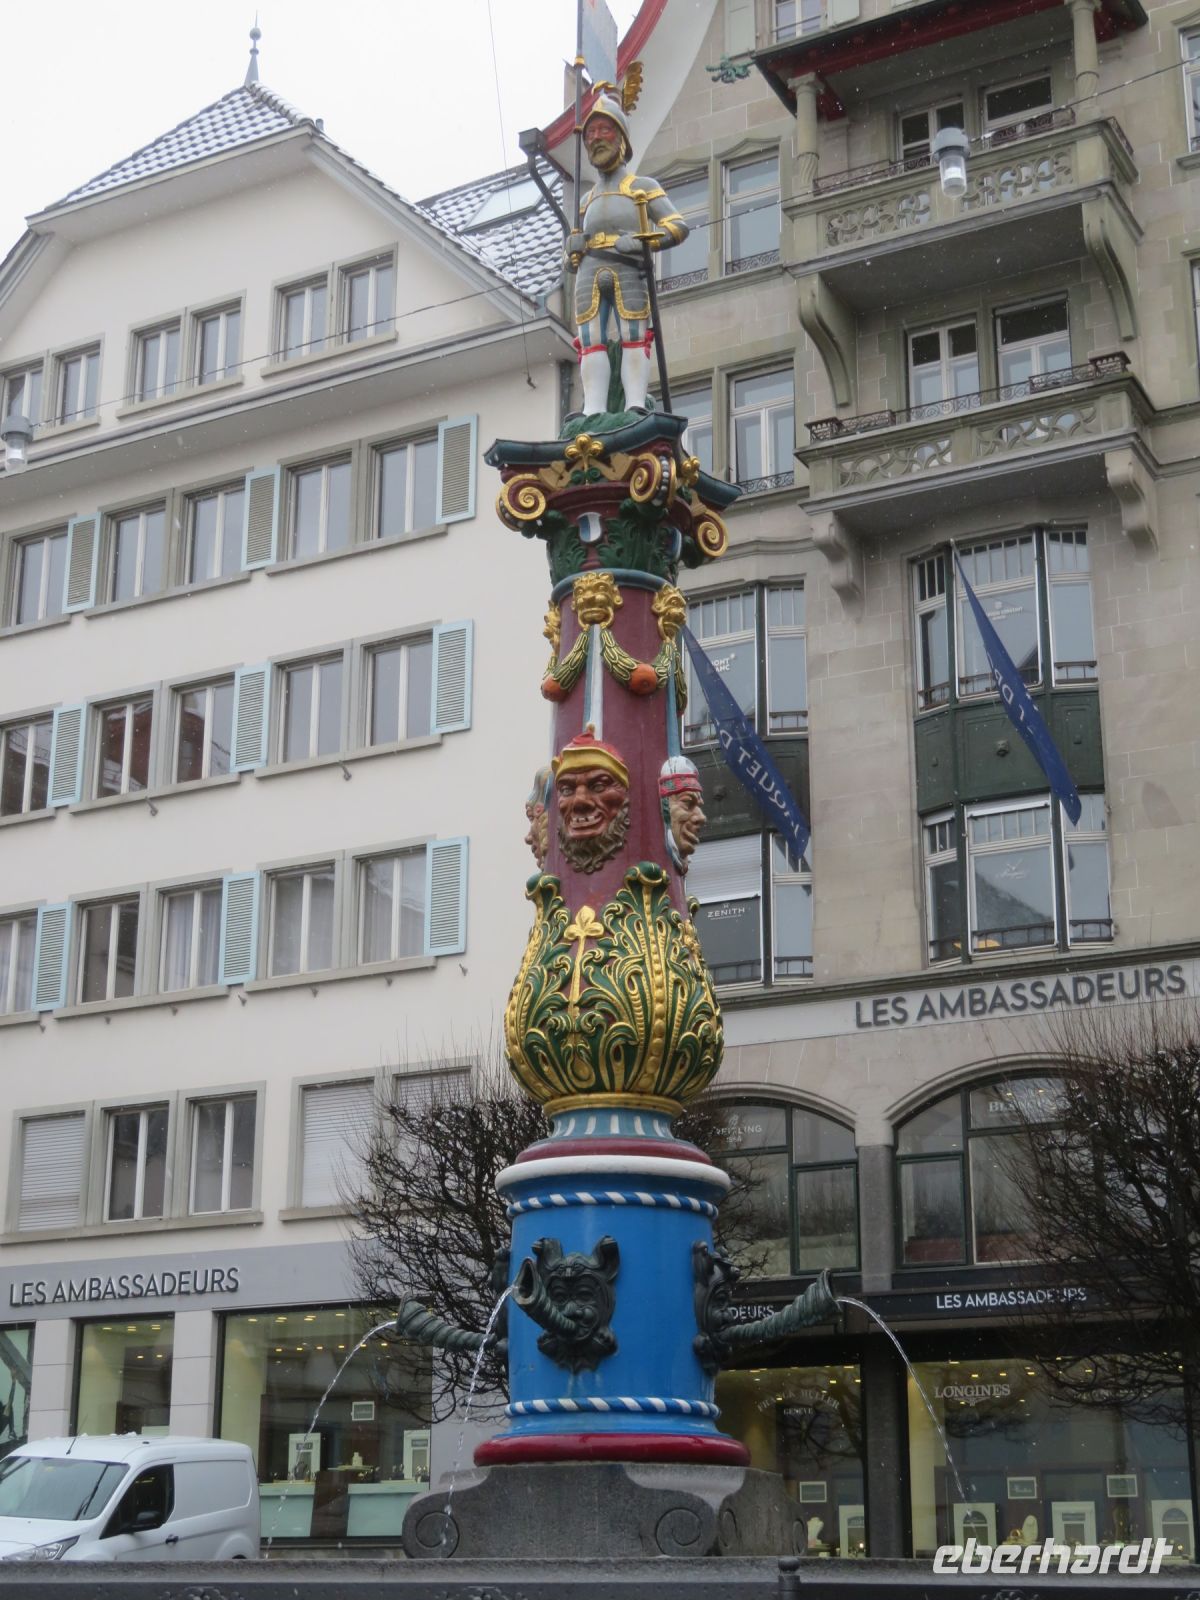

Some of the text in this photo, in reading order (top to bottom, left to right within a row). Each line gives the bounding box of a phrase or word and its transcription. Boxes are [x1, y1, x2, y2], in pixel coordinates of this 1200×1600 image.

[707, 907, 745, 918] ZENITH
[855, 965, 1186, 1028] LES AMBASSADEURS
[10, 1267, 239, 1307] LES AMBASSADEURS
[936, 1287, 1087, 1309] LES AMBASSADEURS
[935, 1383, 1011, 1398] LONGINES
